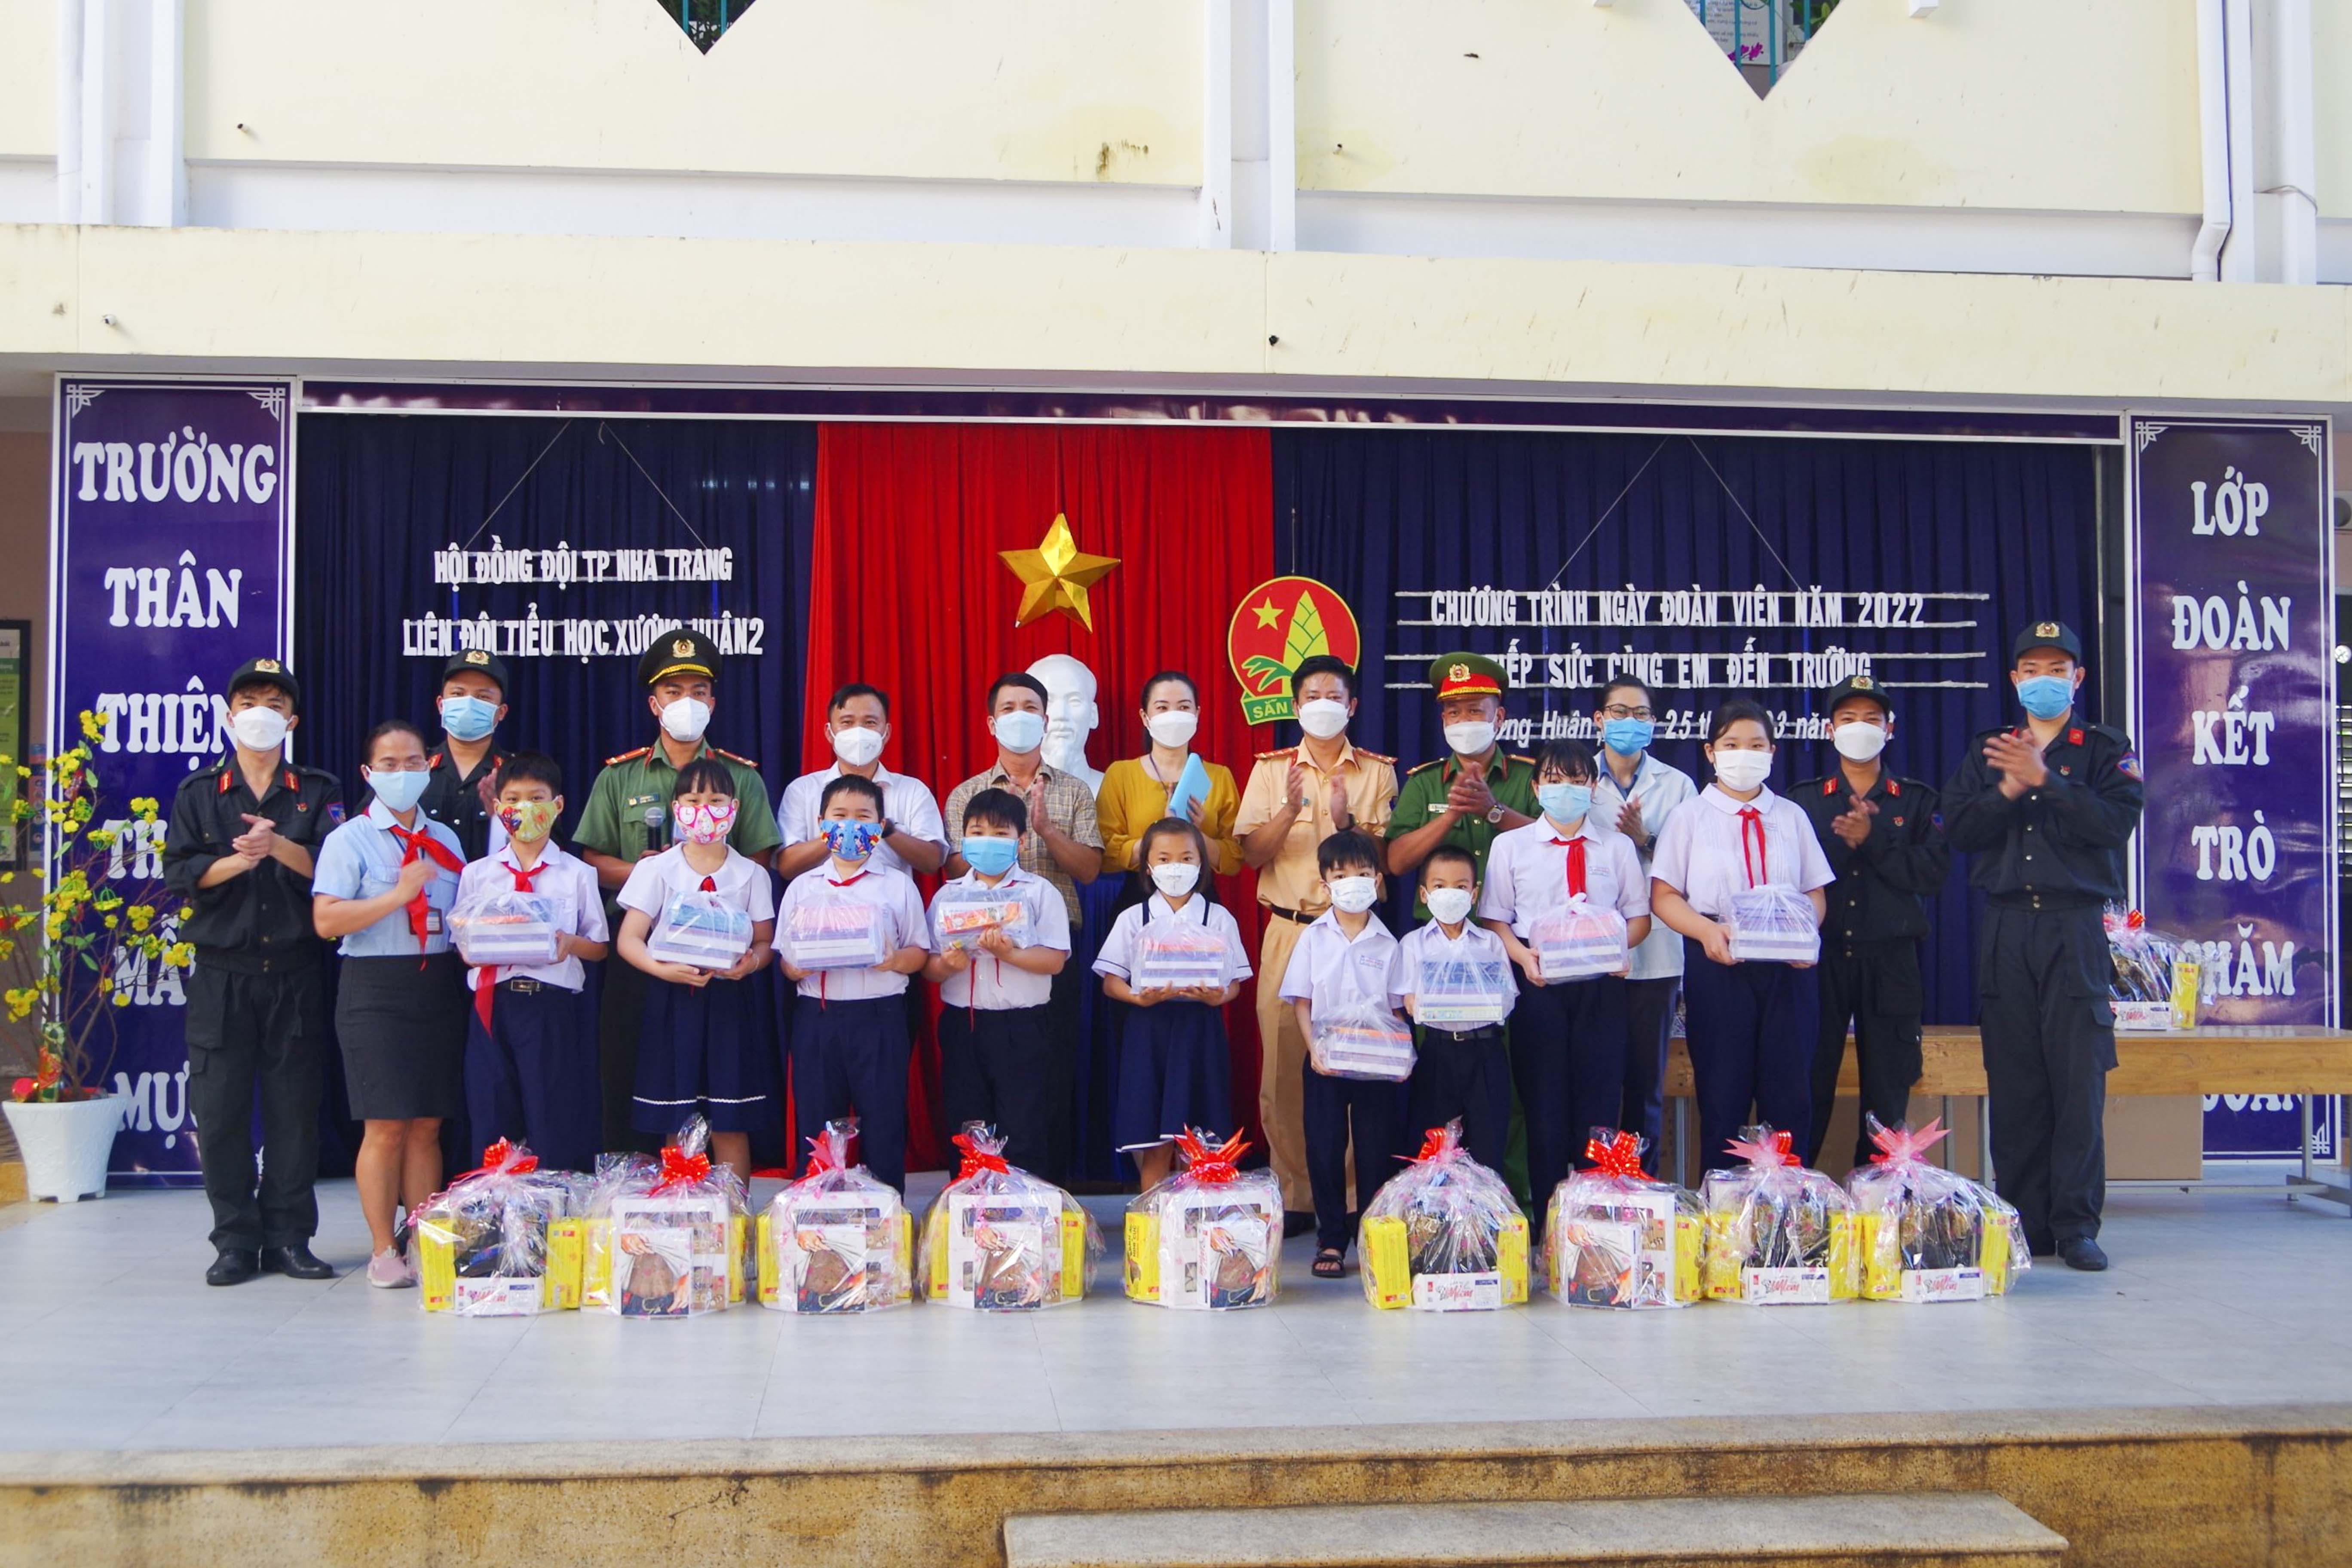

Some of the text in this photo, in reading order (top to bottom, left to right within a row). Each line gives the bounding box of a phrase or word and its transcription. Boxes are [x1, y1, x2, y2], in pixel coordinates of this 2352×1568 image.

[74, 425, 277, 504] TRƯỜNG
[2191, 466, 2269, 536] LỚP
[104, 549, 243, 628] THÂN
[434, 535, 732, 592] HỘI ĐỒNG ĐỘI TP NHA TRANG
[403, 611, 452, 657] LIÊN
[504, 602, 554, 657] TIỂU
[564, 619, 609, 664] HỌC
[1431, 583, 1924, 628] CHƯƠNG TRÌNH NGÀY ĐOÀN VIÊN NĂM 2022
[2171, 580, 2291, 652] ĐOÀN
[1548, 642, 1593, 689] SỨC
[1678, 653, 1709, 688] EM
[1727, 637, 1770, 688] ĐẾN
[1665, 709, 1694, 739] 25
[2192, 685, 2275, 766] KẾT
[2191, 809, 2276, 882] TRÒ
[114, 1060, 198, 1149] MỰ
